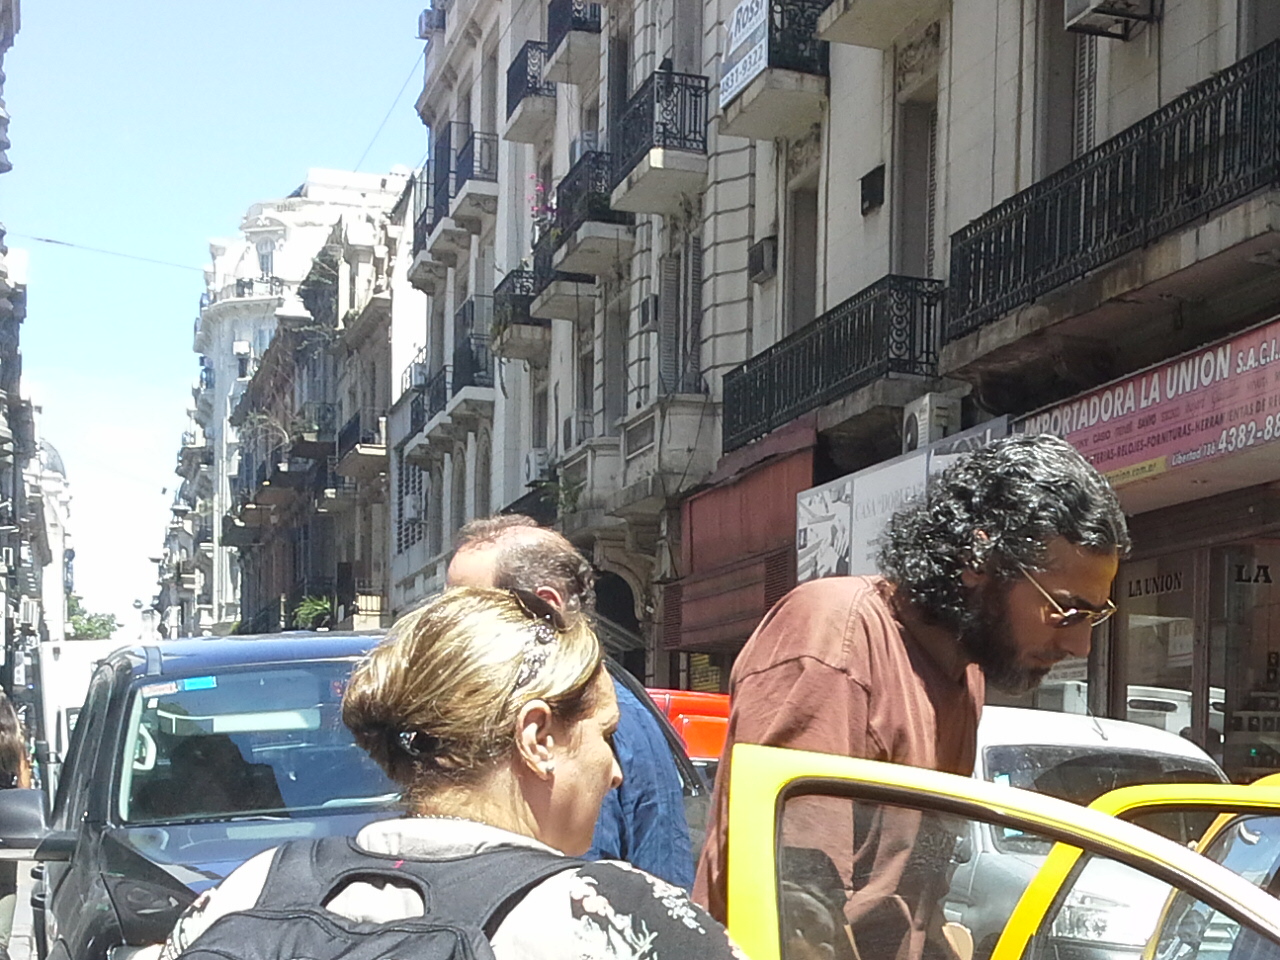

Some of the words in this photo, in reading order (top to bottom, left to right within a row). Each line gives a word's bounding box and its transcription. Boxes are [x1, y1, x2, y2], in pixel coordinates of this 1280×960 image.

[1140, 374, 1161, 405] LA
[1165, 344, 1231, 399] UNION
[1128, 579, 1143, 598] LA
[1145, 572, 1183, 595] UNION
[1234, 564, 1273, 584] LA
